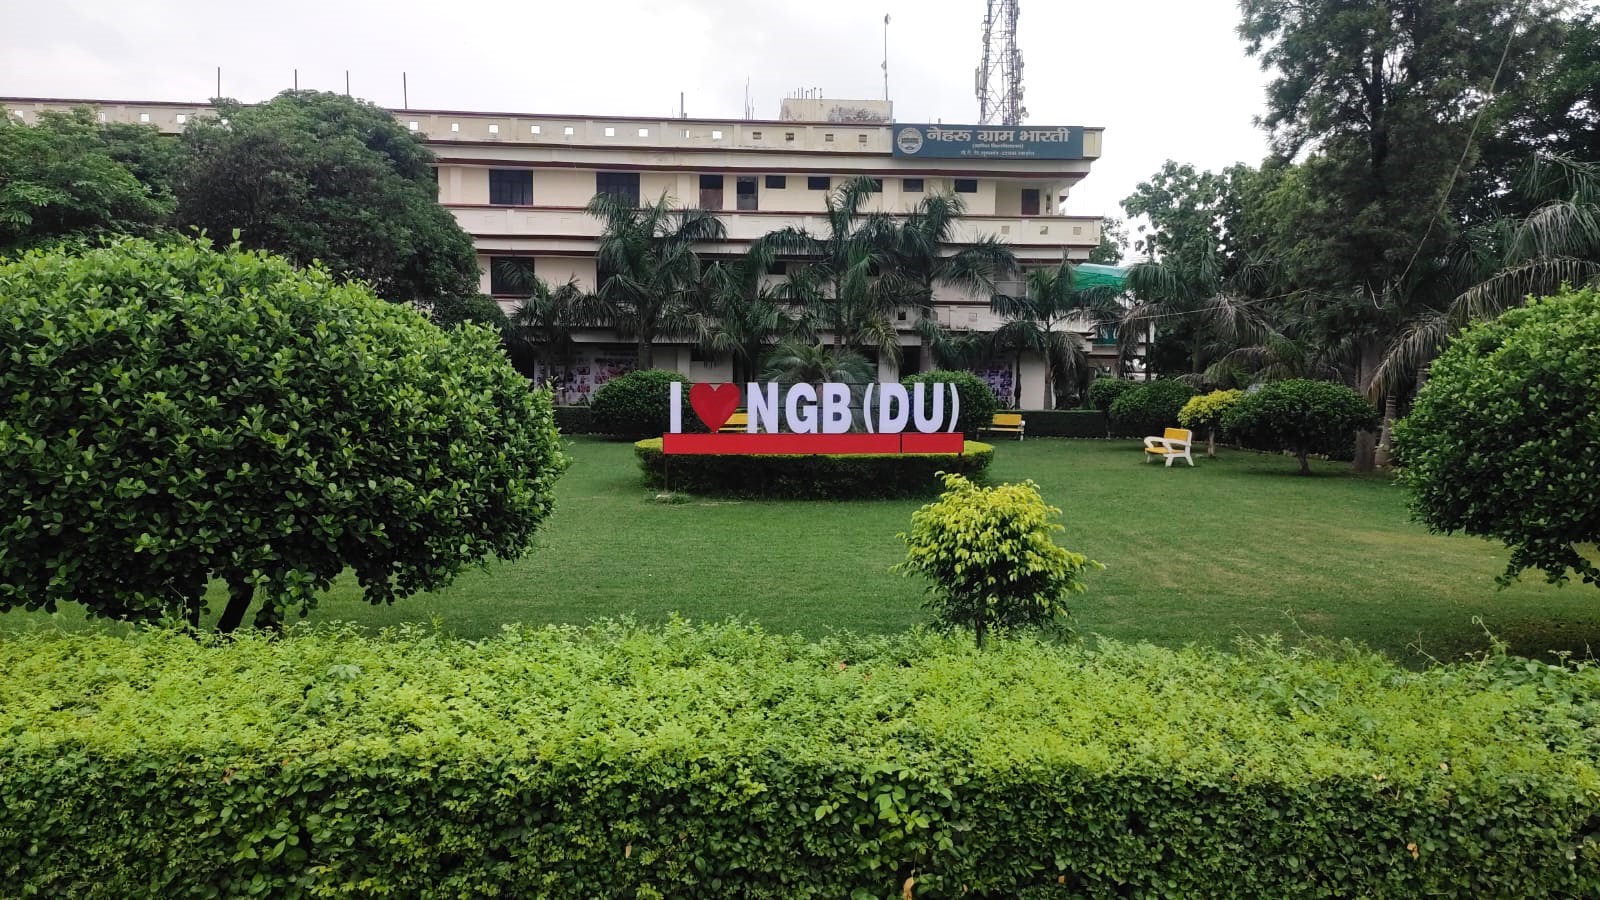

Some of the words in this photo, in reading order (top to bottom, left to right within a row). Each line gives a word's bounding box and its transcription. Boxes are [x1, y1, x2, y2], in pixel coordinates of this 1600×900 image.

[926, 127, 972, 142] नेहरू
[977, 130, 1016, 143] ग्राम
[1019, 127, 1071, 143] भारती
[670, 382, 682, 433] I
